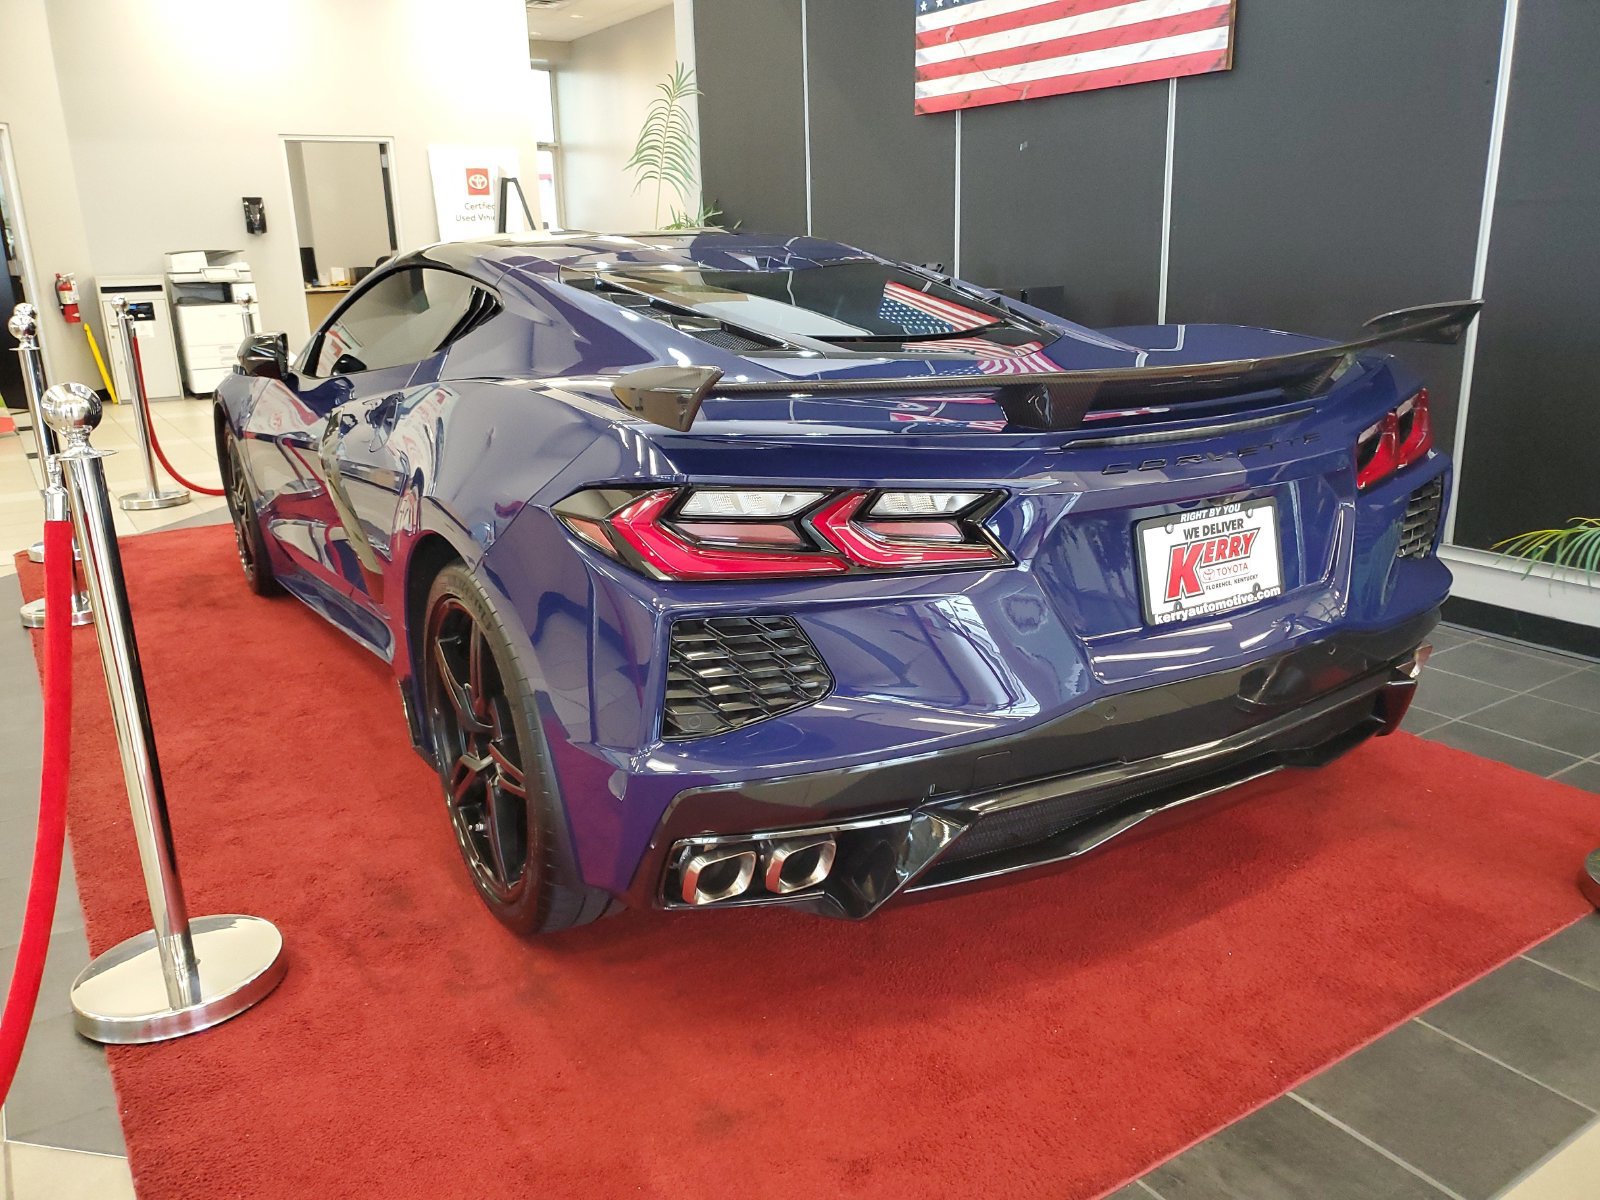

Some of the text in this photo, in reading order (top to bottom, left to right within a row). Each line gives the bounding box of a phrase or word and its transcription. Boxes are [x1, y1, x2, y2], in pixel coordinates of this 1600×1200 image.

[1102, 432, 1321, 475] CORVETTE
[1180, 503, 1241, 523] RIGHT BY YOU
[1183, 518, 1245, 540] WE DELIVER
[1165, 529, 1258, 601] KERRY
[1216, 562, 1249, 576] TOYOTA
[1233, 574, 1259, 585] KENTUCKY
[1154, 586, 1281, 625] kerryautomotive.com
